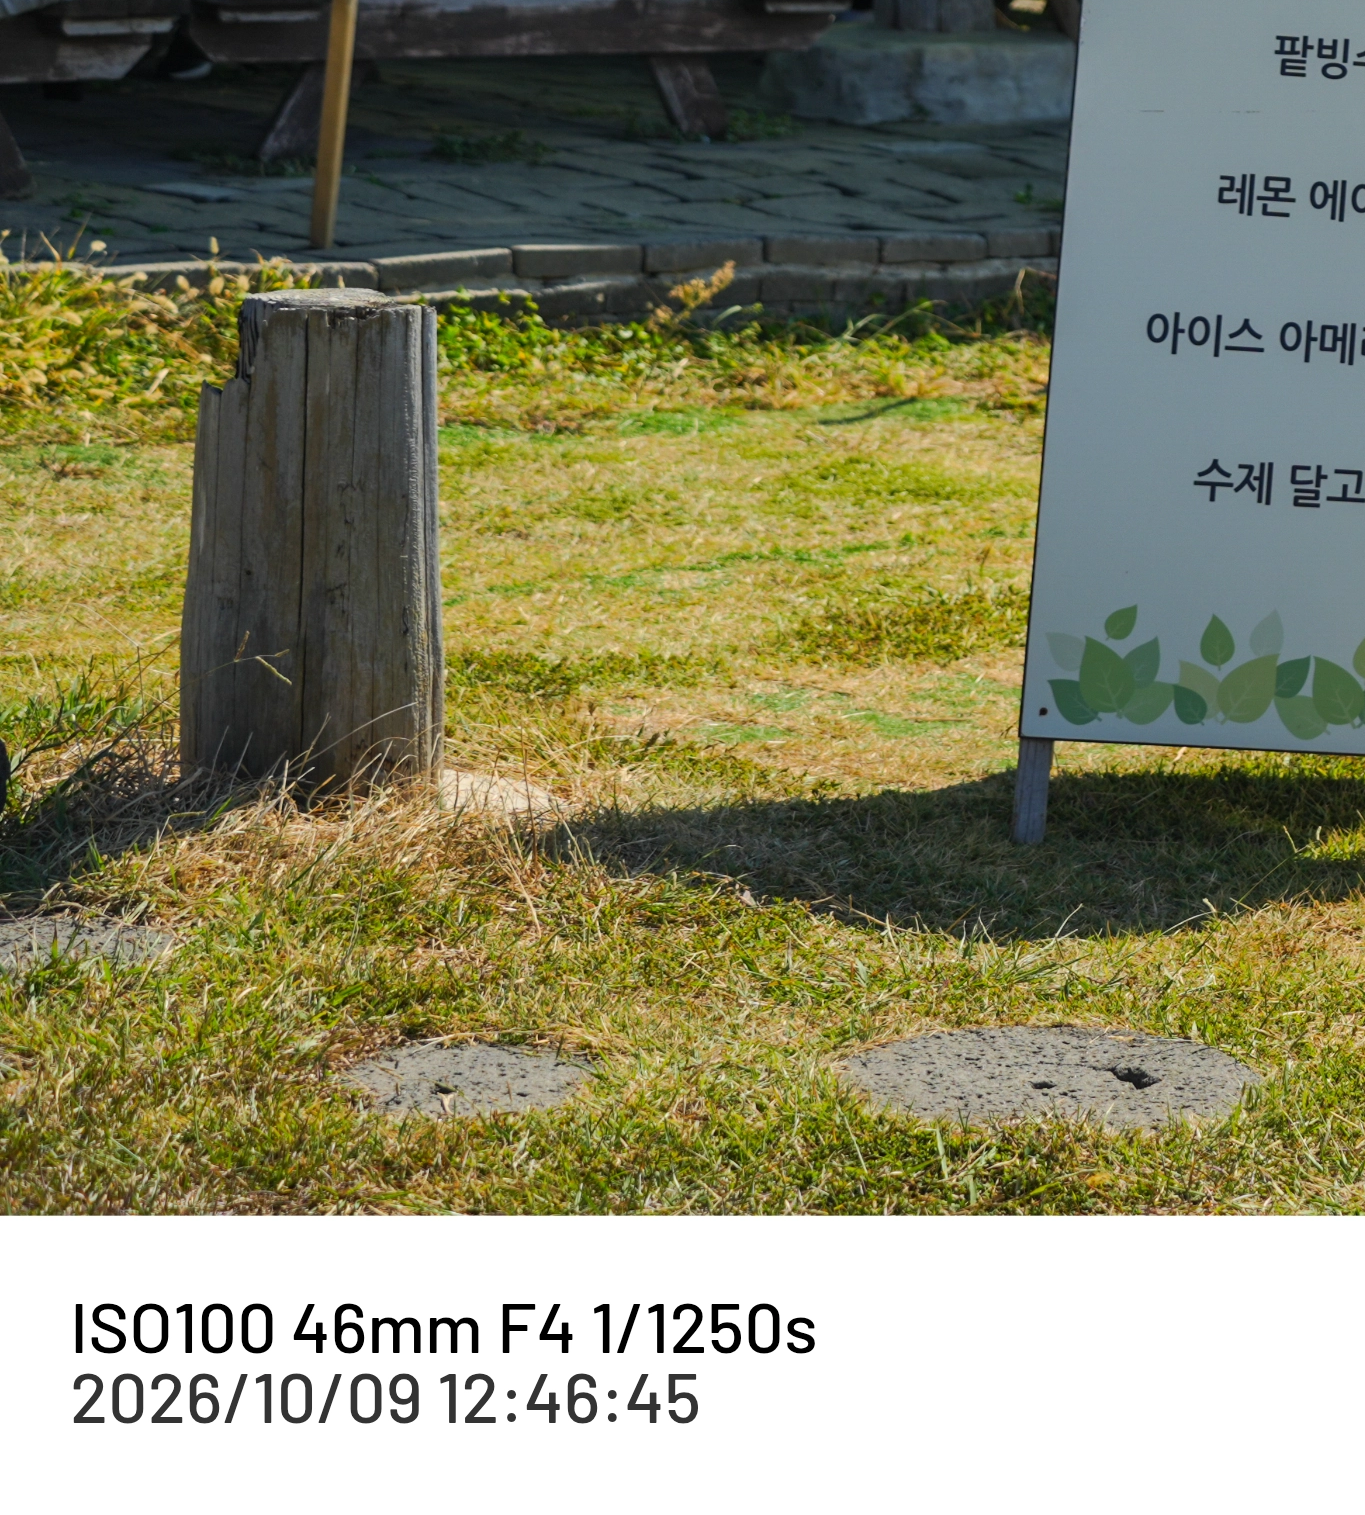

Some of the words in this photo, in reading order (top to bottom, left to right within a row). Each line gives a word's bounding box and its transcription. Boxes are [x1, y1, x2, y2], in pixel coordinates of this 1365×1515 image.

[1217, 173, 1297, 218] 레몬
[1146, 311, 1266, 358] 아이스
[1192, 458, 1275, 506] 수제
